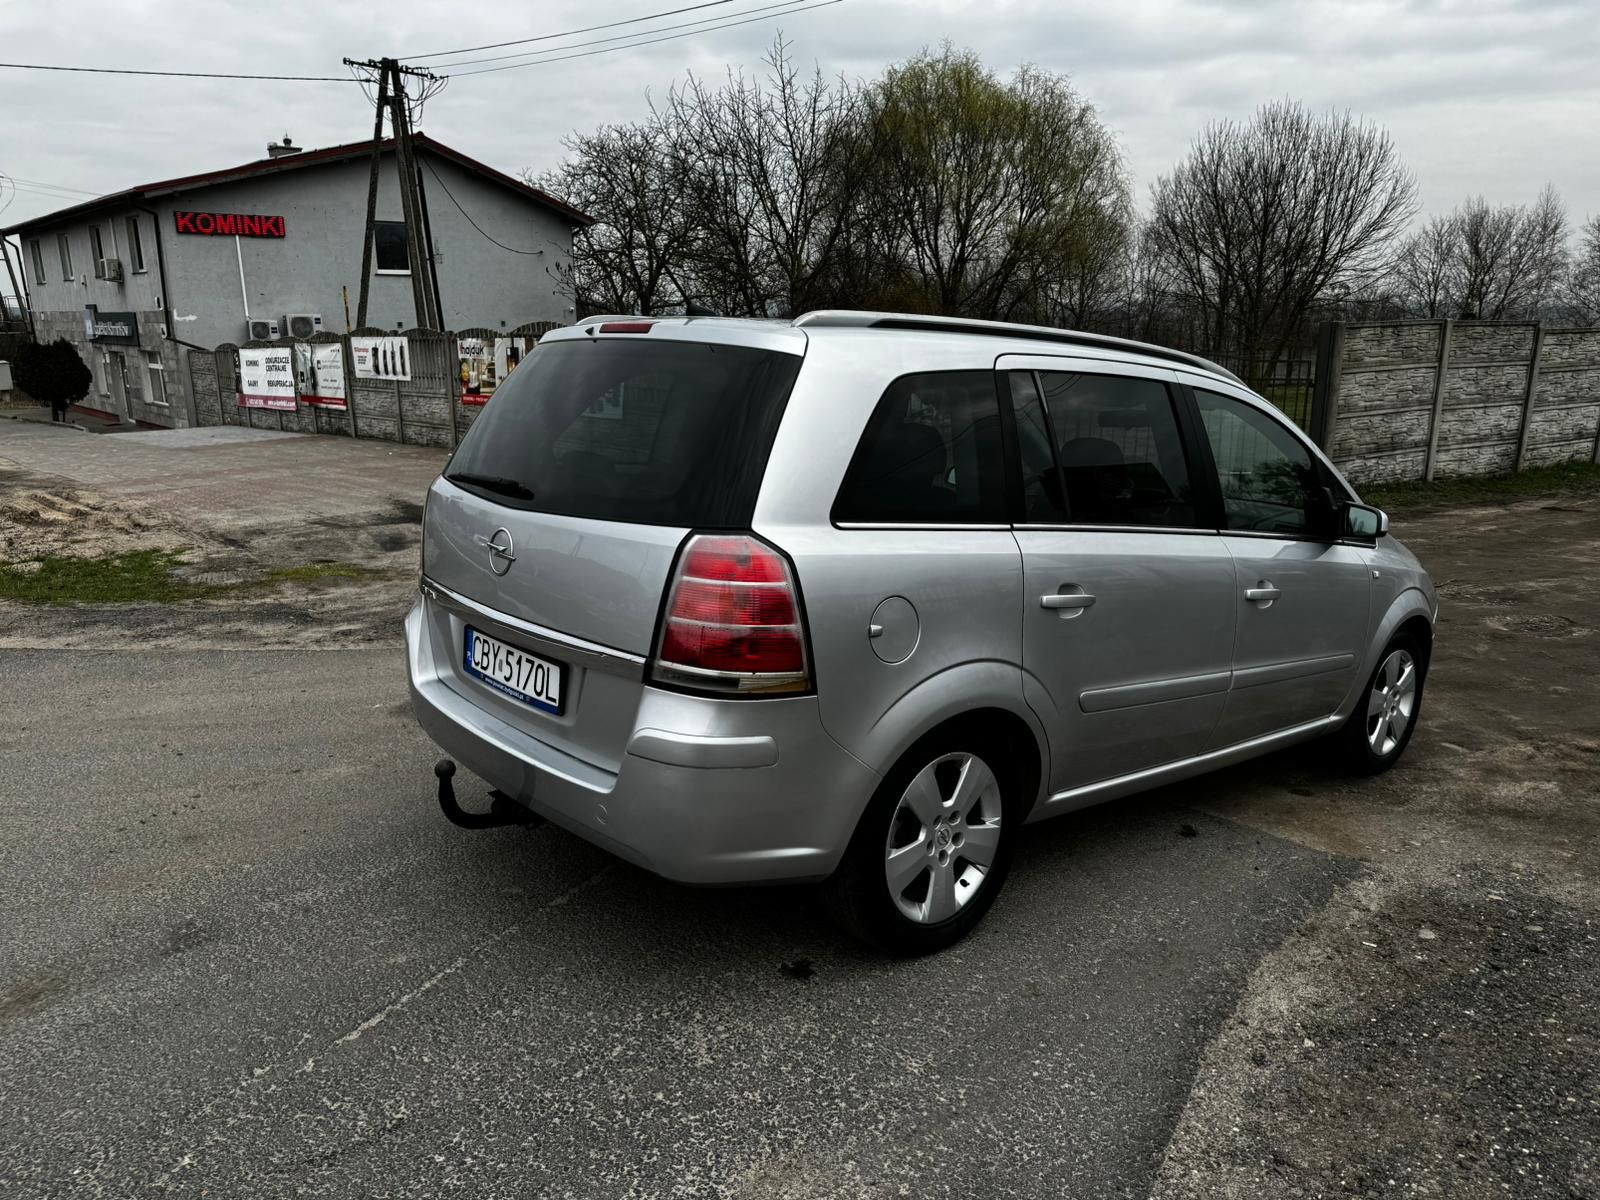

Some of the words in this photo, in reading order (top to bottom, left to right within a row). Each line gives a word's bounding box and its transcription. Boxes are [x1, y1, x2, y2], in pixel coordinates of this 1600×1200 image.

[175, 211, 285, 236] KOMINKI
[265, 364, 286, 372] CENTRALNE
[473, 635, 501, 675] CBY
[503, 649, 557, 703] 5170L
